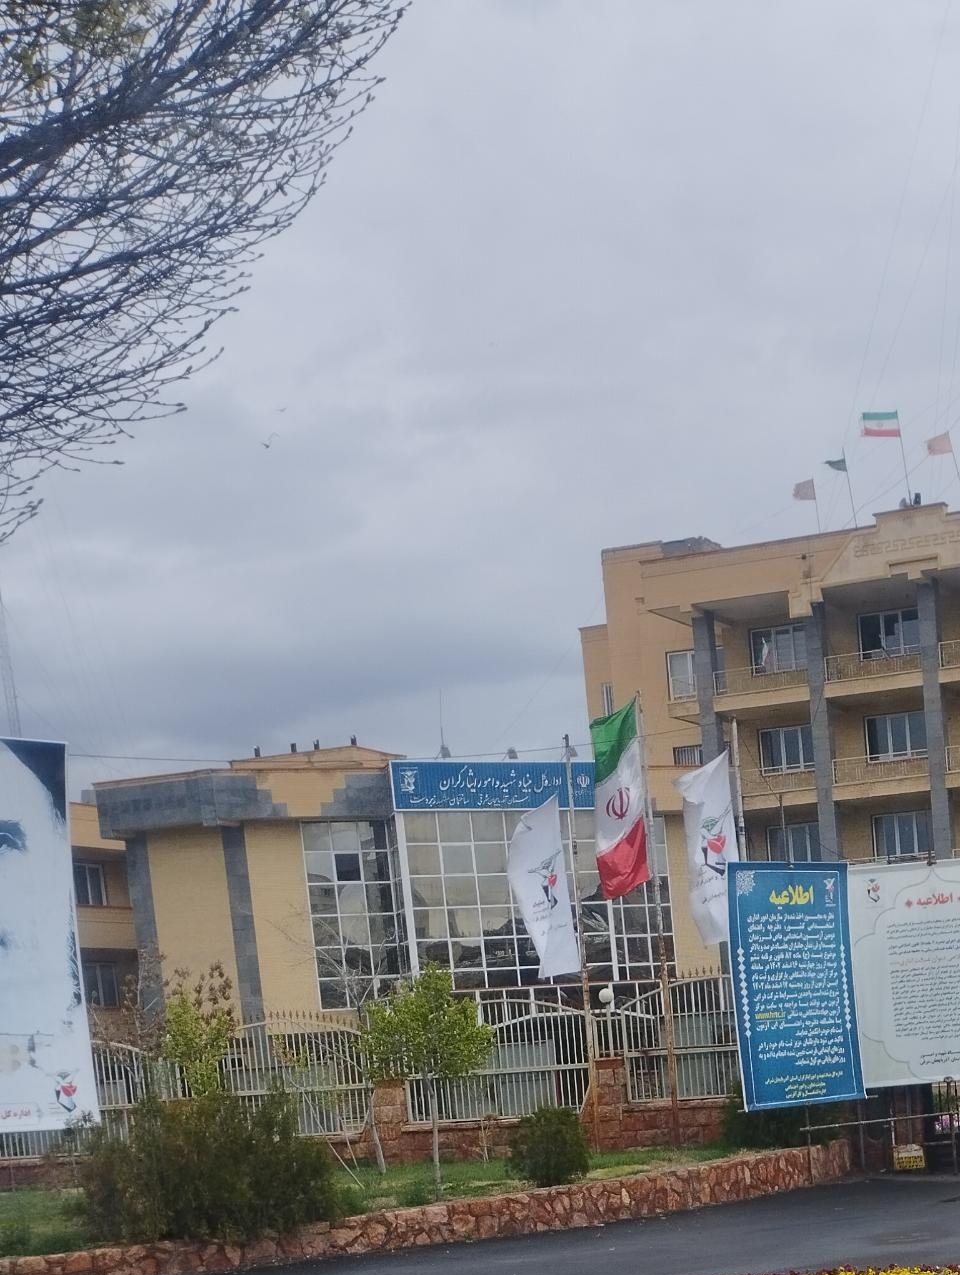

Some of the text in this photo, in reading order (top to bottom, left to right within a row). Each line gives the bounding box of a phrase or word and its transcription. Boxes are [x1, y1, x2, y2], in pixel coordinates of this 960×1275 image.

[439, 765, 477, 793] ایثارگران
[477, 777, 495, 789] امور
[500, 769, 517, 793] شهید
[518, 773, 532, 793] بنیاد
[533, 769, 547, 793] کل
[769, 884, 814, 910] اطلاعیه
[916, 892, 953, 909] اطلاعیه
[1, 1107, 13, 1120] کل
[13, 1107, 32, 1121] اداره
